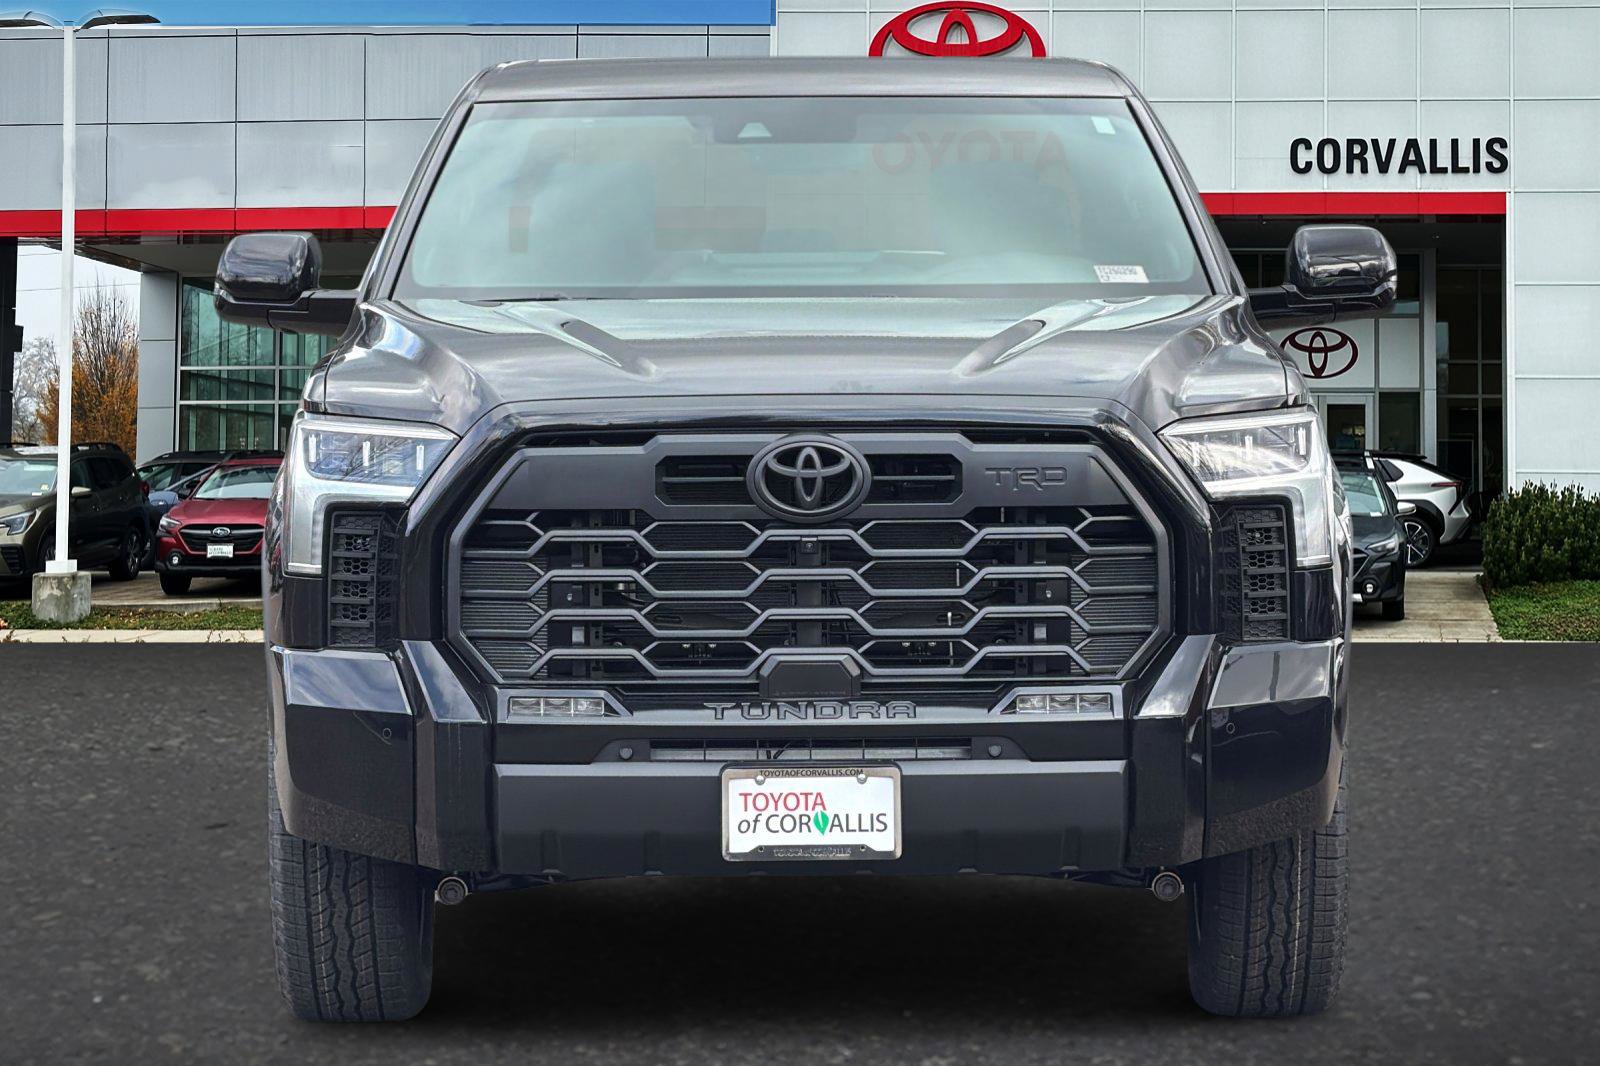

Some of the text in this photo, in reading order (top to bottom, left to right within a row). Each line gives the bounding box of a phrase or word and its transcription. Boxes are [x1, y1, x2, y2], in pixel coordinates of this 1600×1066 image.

[1289, 137, 1509, 174] CORVALLIS
[984, 466, 1068, 491] TRD
[703, 701, 917, 720] TUNDRA
[759, 769, 864, 778] TOYOTAOFCORVALLIS.COM
[739, 791, 827, 812] TOYOTA
[737, 814, 762, 834] of
